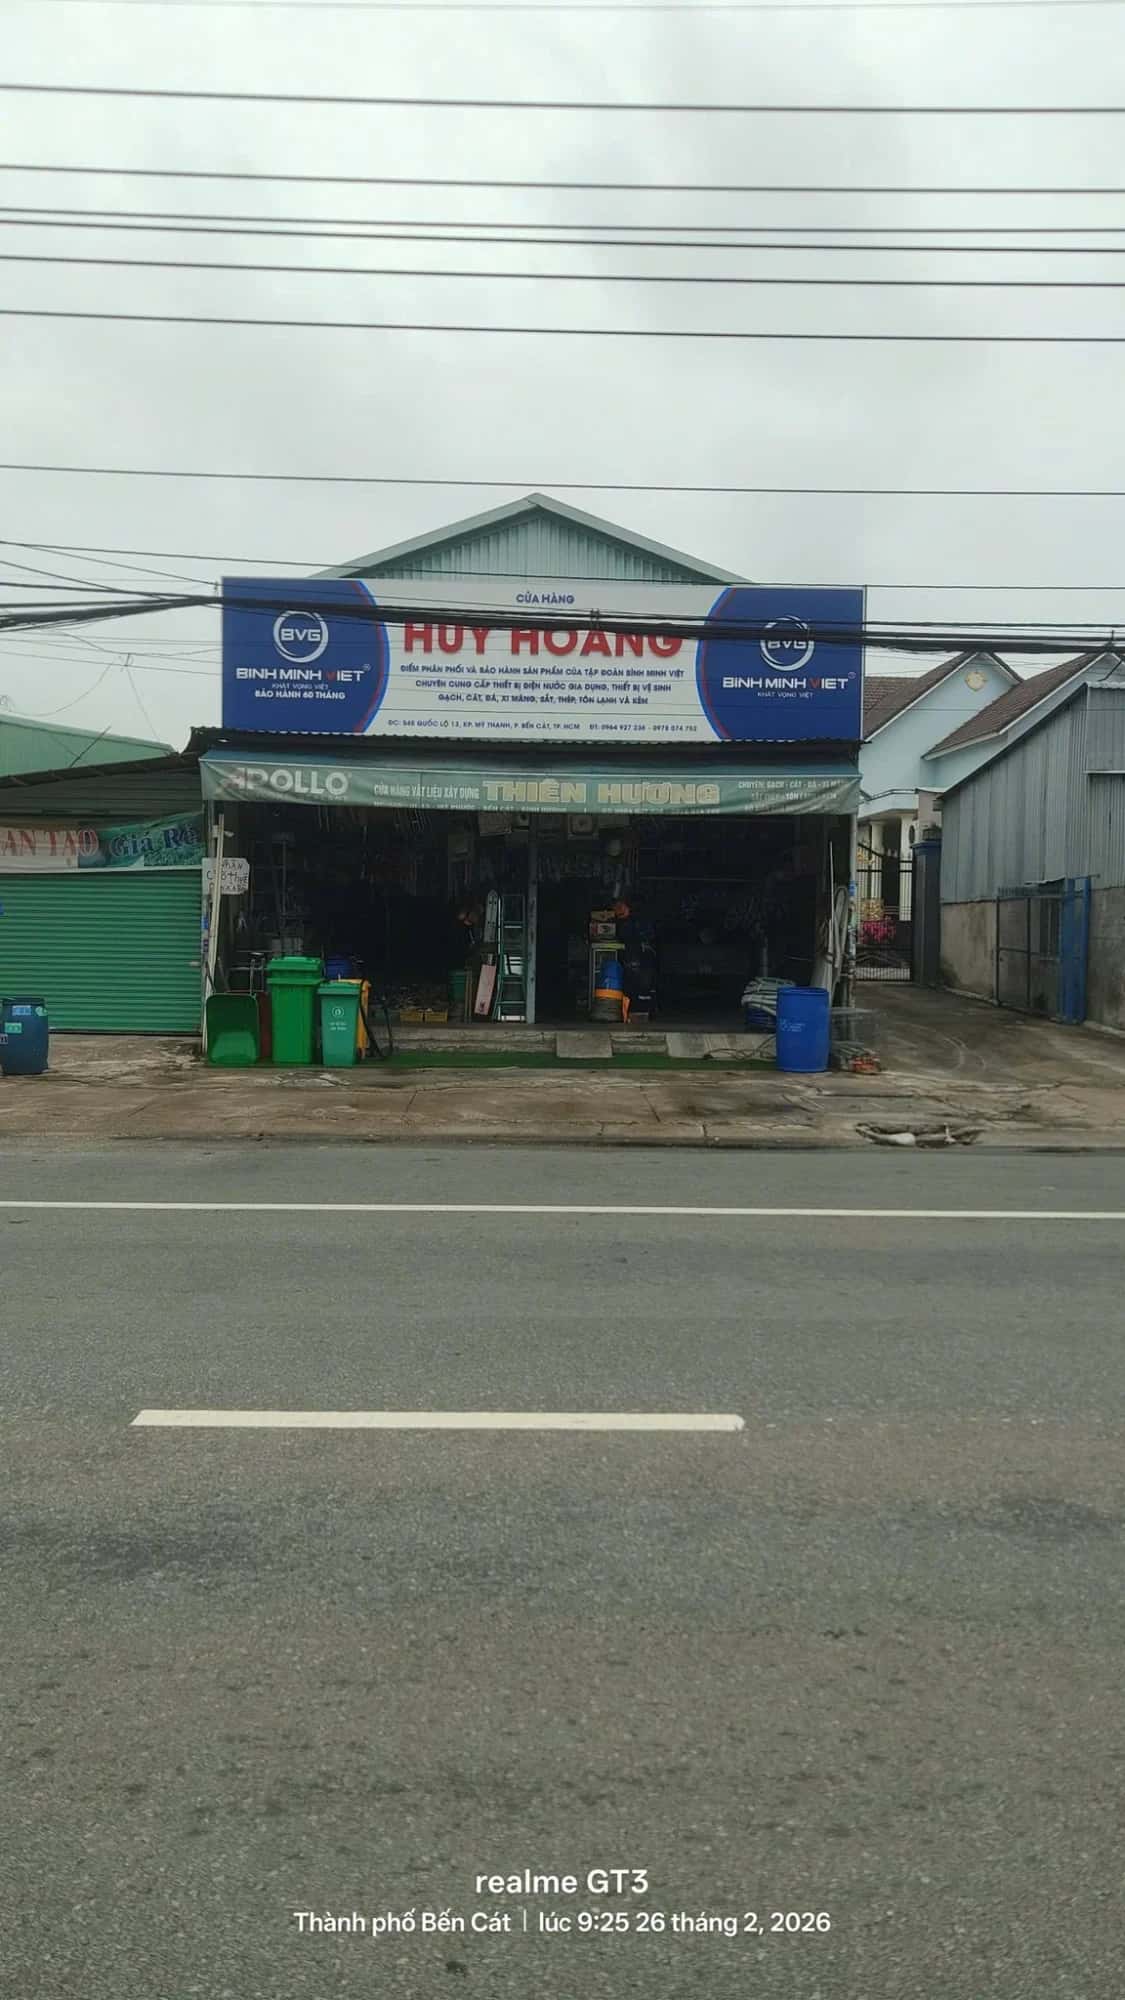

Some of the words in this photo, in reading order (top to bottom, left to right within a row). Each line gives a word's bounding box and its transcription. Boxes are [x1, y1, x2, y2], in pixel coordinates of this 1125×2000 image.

[516, 589, 540, 603] CỬA
[541, 592, 575, 604] HÀNG
[281, 628, 321, 641] BVG
[400, 662, 420, 673] ĐIỂM
[421, 664, 443, 673] PHÂN
[445, 663, 464, 673] PHỐI
[465, 665, 478, 674] VÀ
[479, 665, 497, 674] BẢO
[498, 665, 521, 675] HÀNH
[522, 666, 539, 675] SẢN
[540, 665, 563, 675] PHẨM
[565, 667, 582, 676] CỦA
[584, 667, 599, 678] TẬP
[601, 667, 624, 677] ĐOÀN
[625, 667, 645, 677] BÌNH
[646, 669, 667, 678] MINH
[668, 669, 685, 679] VIỆT
[415, 680, 447, 688] CHUYÊN
[448, 680, 472, 688] CUNG
[473, 679, 491, 688] CẤP
[493, 680, 512, 689] THIẾT
[514, 682, 521, 690] BỊ
[523, 681, 541, 691] ĐIỆN
[543, 681, 566, 690] NƯỚC
[584, 683, 610, 692] DỤNG,
[611, 681, 631, 691] THIẾT
[632, 683, 640, 692] BỊ
[642, 683, 651, 693] VỆ
[653, 684, 672, 692] SINH
[254, 688, 274, 698] BẢO
[275, 689, 301, 699] HÀNH
[302, 690, 314, 699] 60
[315, 690, 346, 700] THÁNG
[438, 694, 464, 703] GẠCH,
[485, 693, 499, 703] ĐÁ,
[511, 694, 538, 704] MĂNG,
[579, 695, 595, 704] TÔN
[596, 697, 617, 706] LẠNH
[619, 696, 630, 704] VÀ
[416, 718, 440, 727] QUỐC
[440, 719, 449, 728] LỘ
[521, 721, 534, 729] BẾN
[482, 778, 586, 804] THIÊN
[598, 781, 720, 805] HƯƠNG
